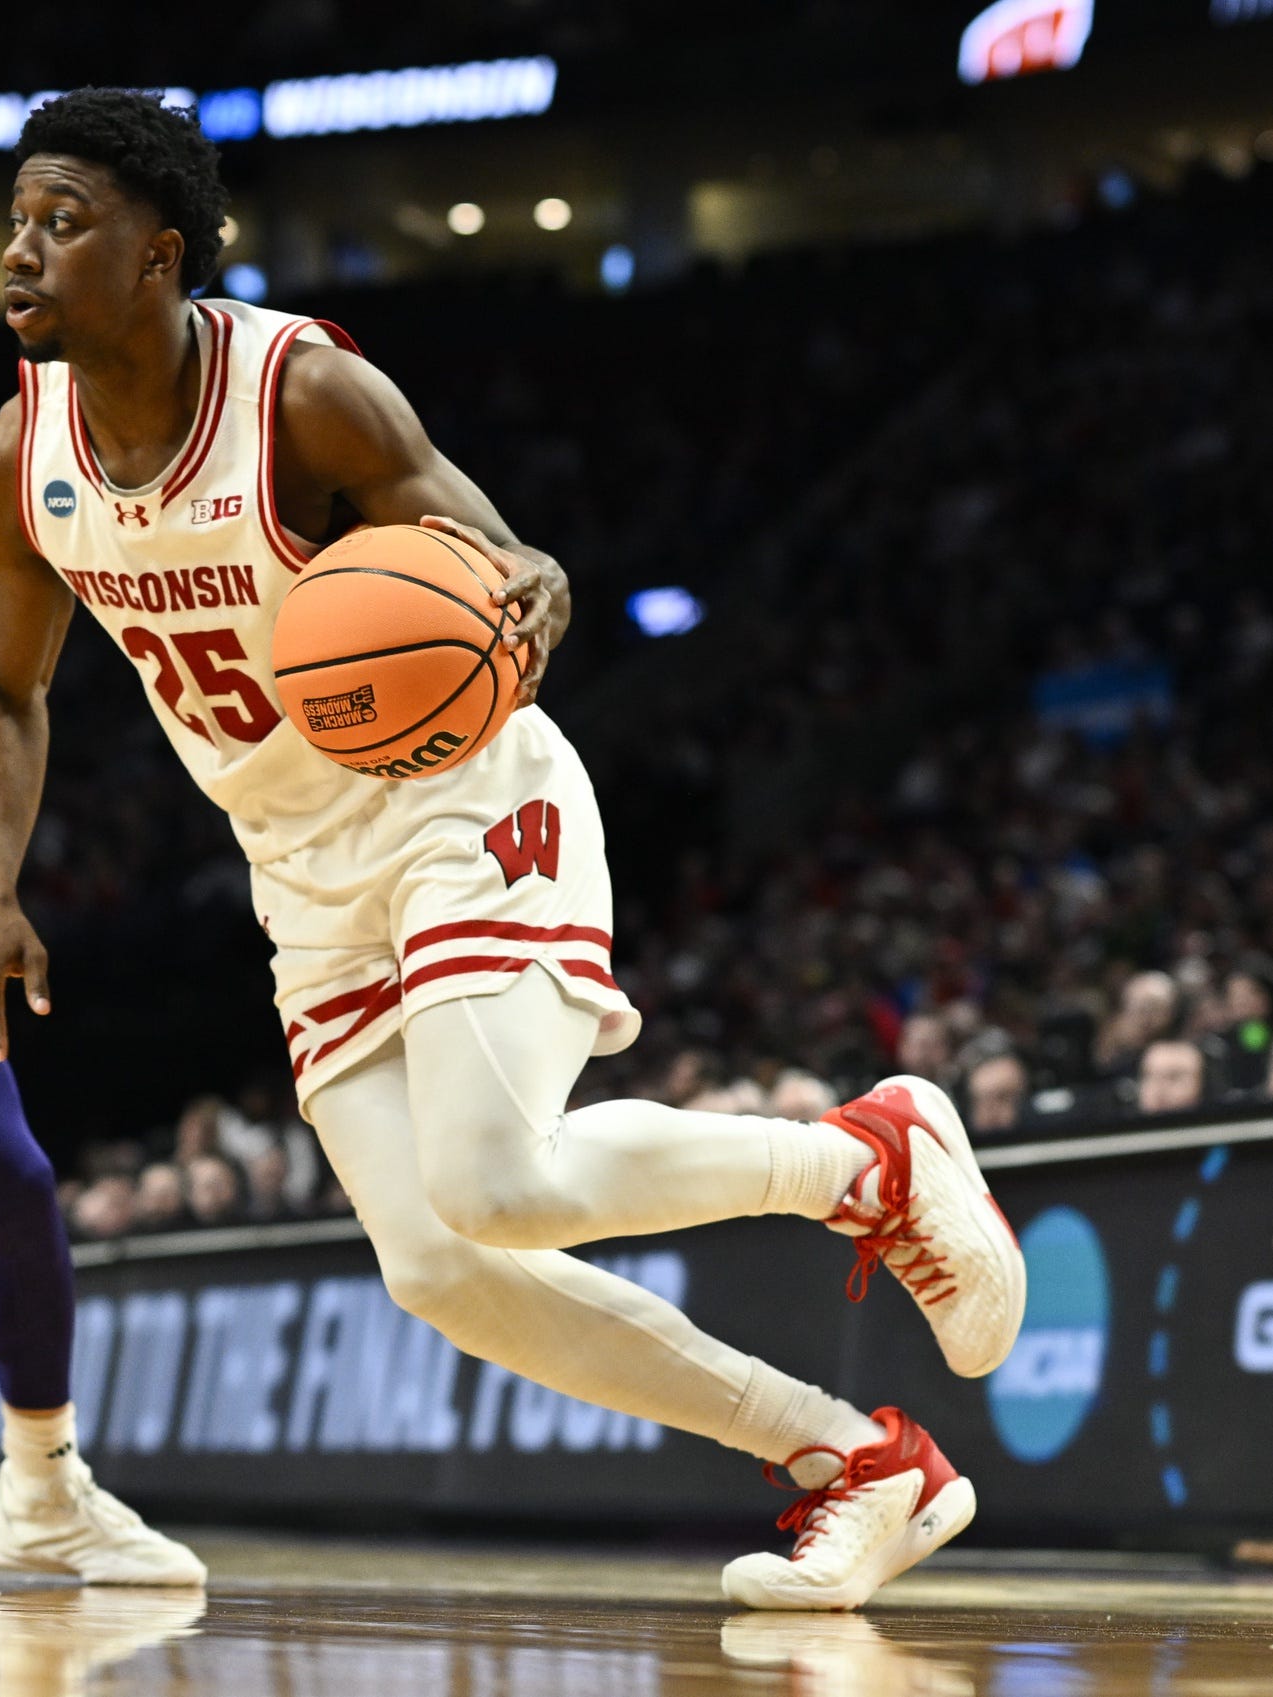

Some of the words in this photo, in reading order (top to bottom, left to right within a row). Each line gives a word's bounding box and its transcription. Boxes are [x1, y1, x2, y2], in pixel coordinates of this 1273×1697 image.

[47, 496, 75, 508] NCAA
[60, 565, 260, 613] WISCONSIN
[122, 626, 283, 748] 25
[303, 698, 353, 717] MADNESS
[323, 710, 363, 729] MARCH
[483, 798, 561, 890] W
